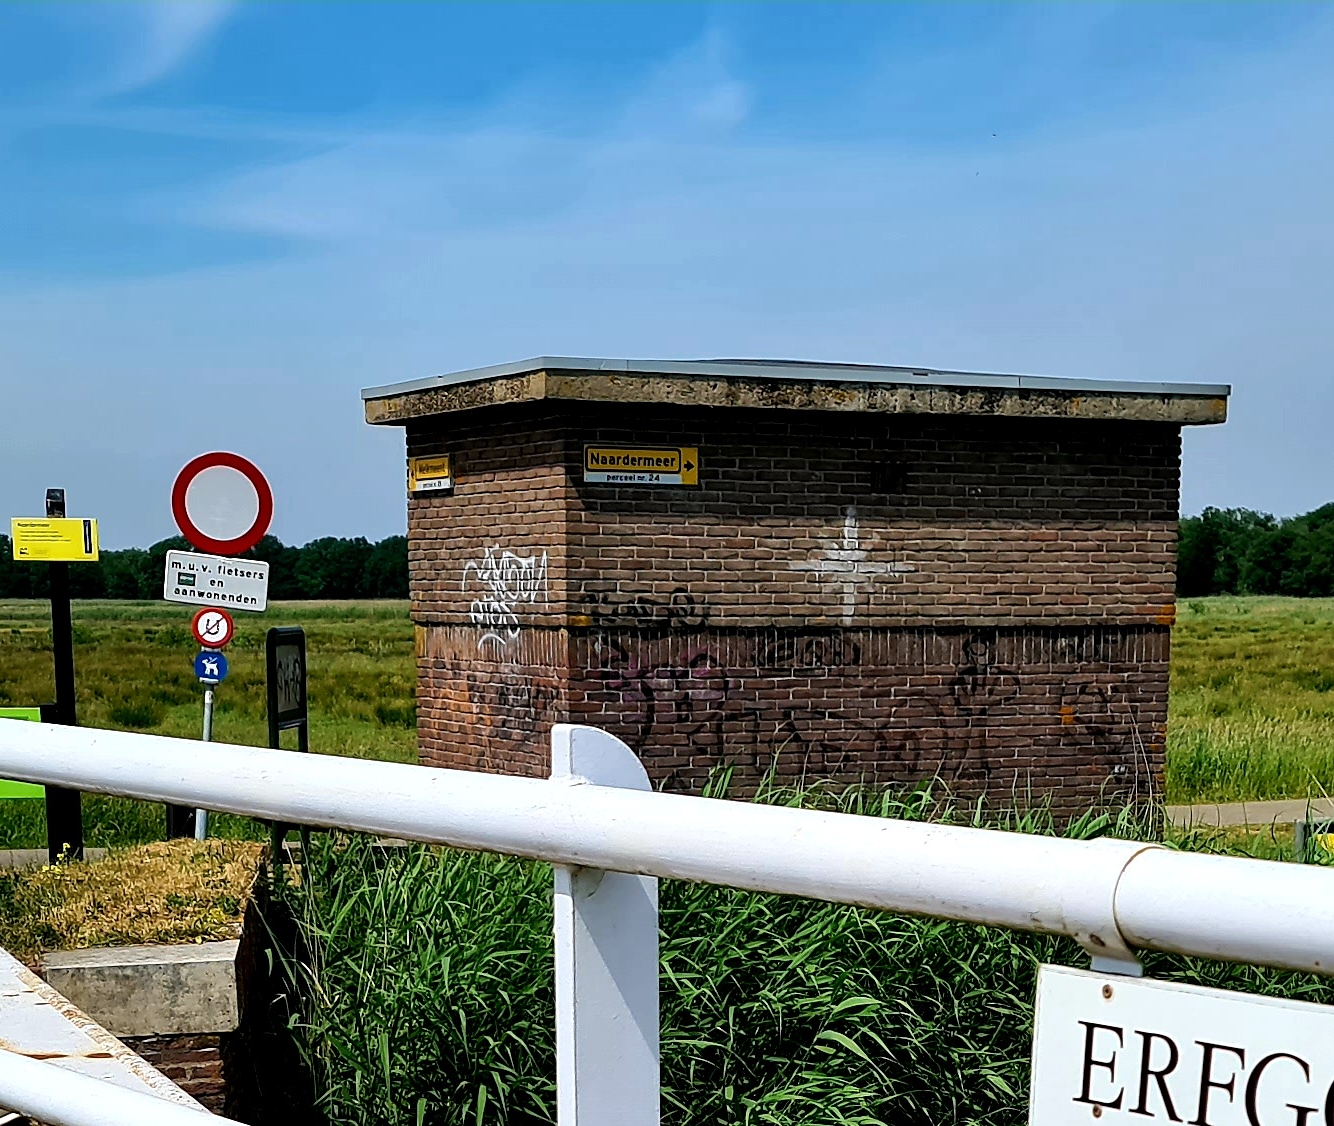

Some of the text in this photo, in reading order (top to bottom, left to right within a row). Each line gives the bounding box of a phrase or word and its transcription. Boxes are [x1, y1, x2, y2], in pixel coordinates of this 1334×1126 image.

[590, 452, 676, 467] Naardermeer
[648, 474, 660, 482] 24
[171, 561, 265, 580] m.u.v. fietsers
[209, 579, 224, 588] en
[174, 587, 257, 605] aanwonenden
